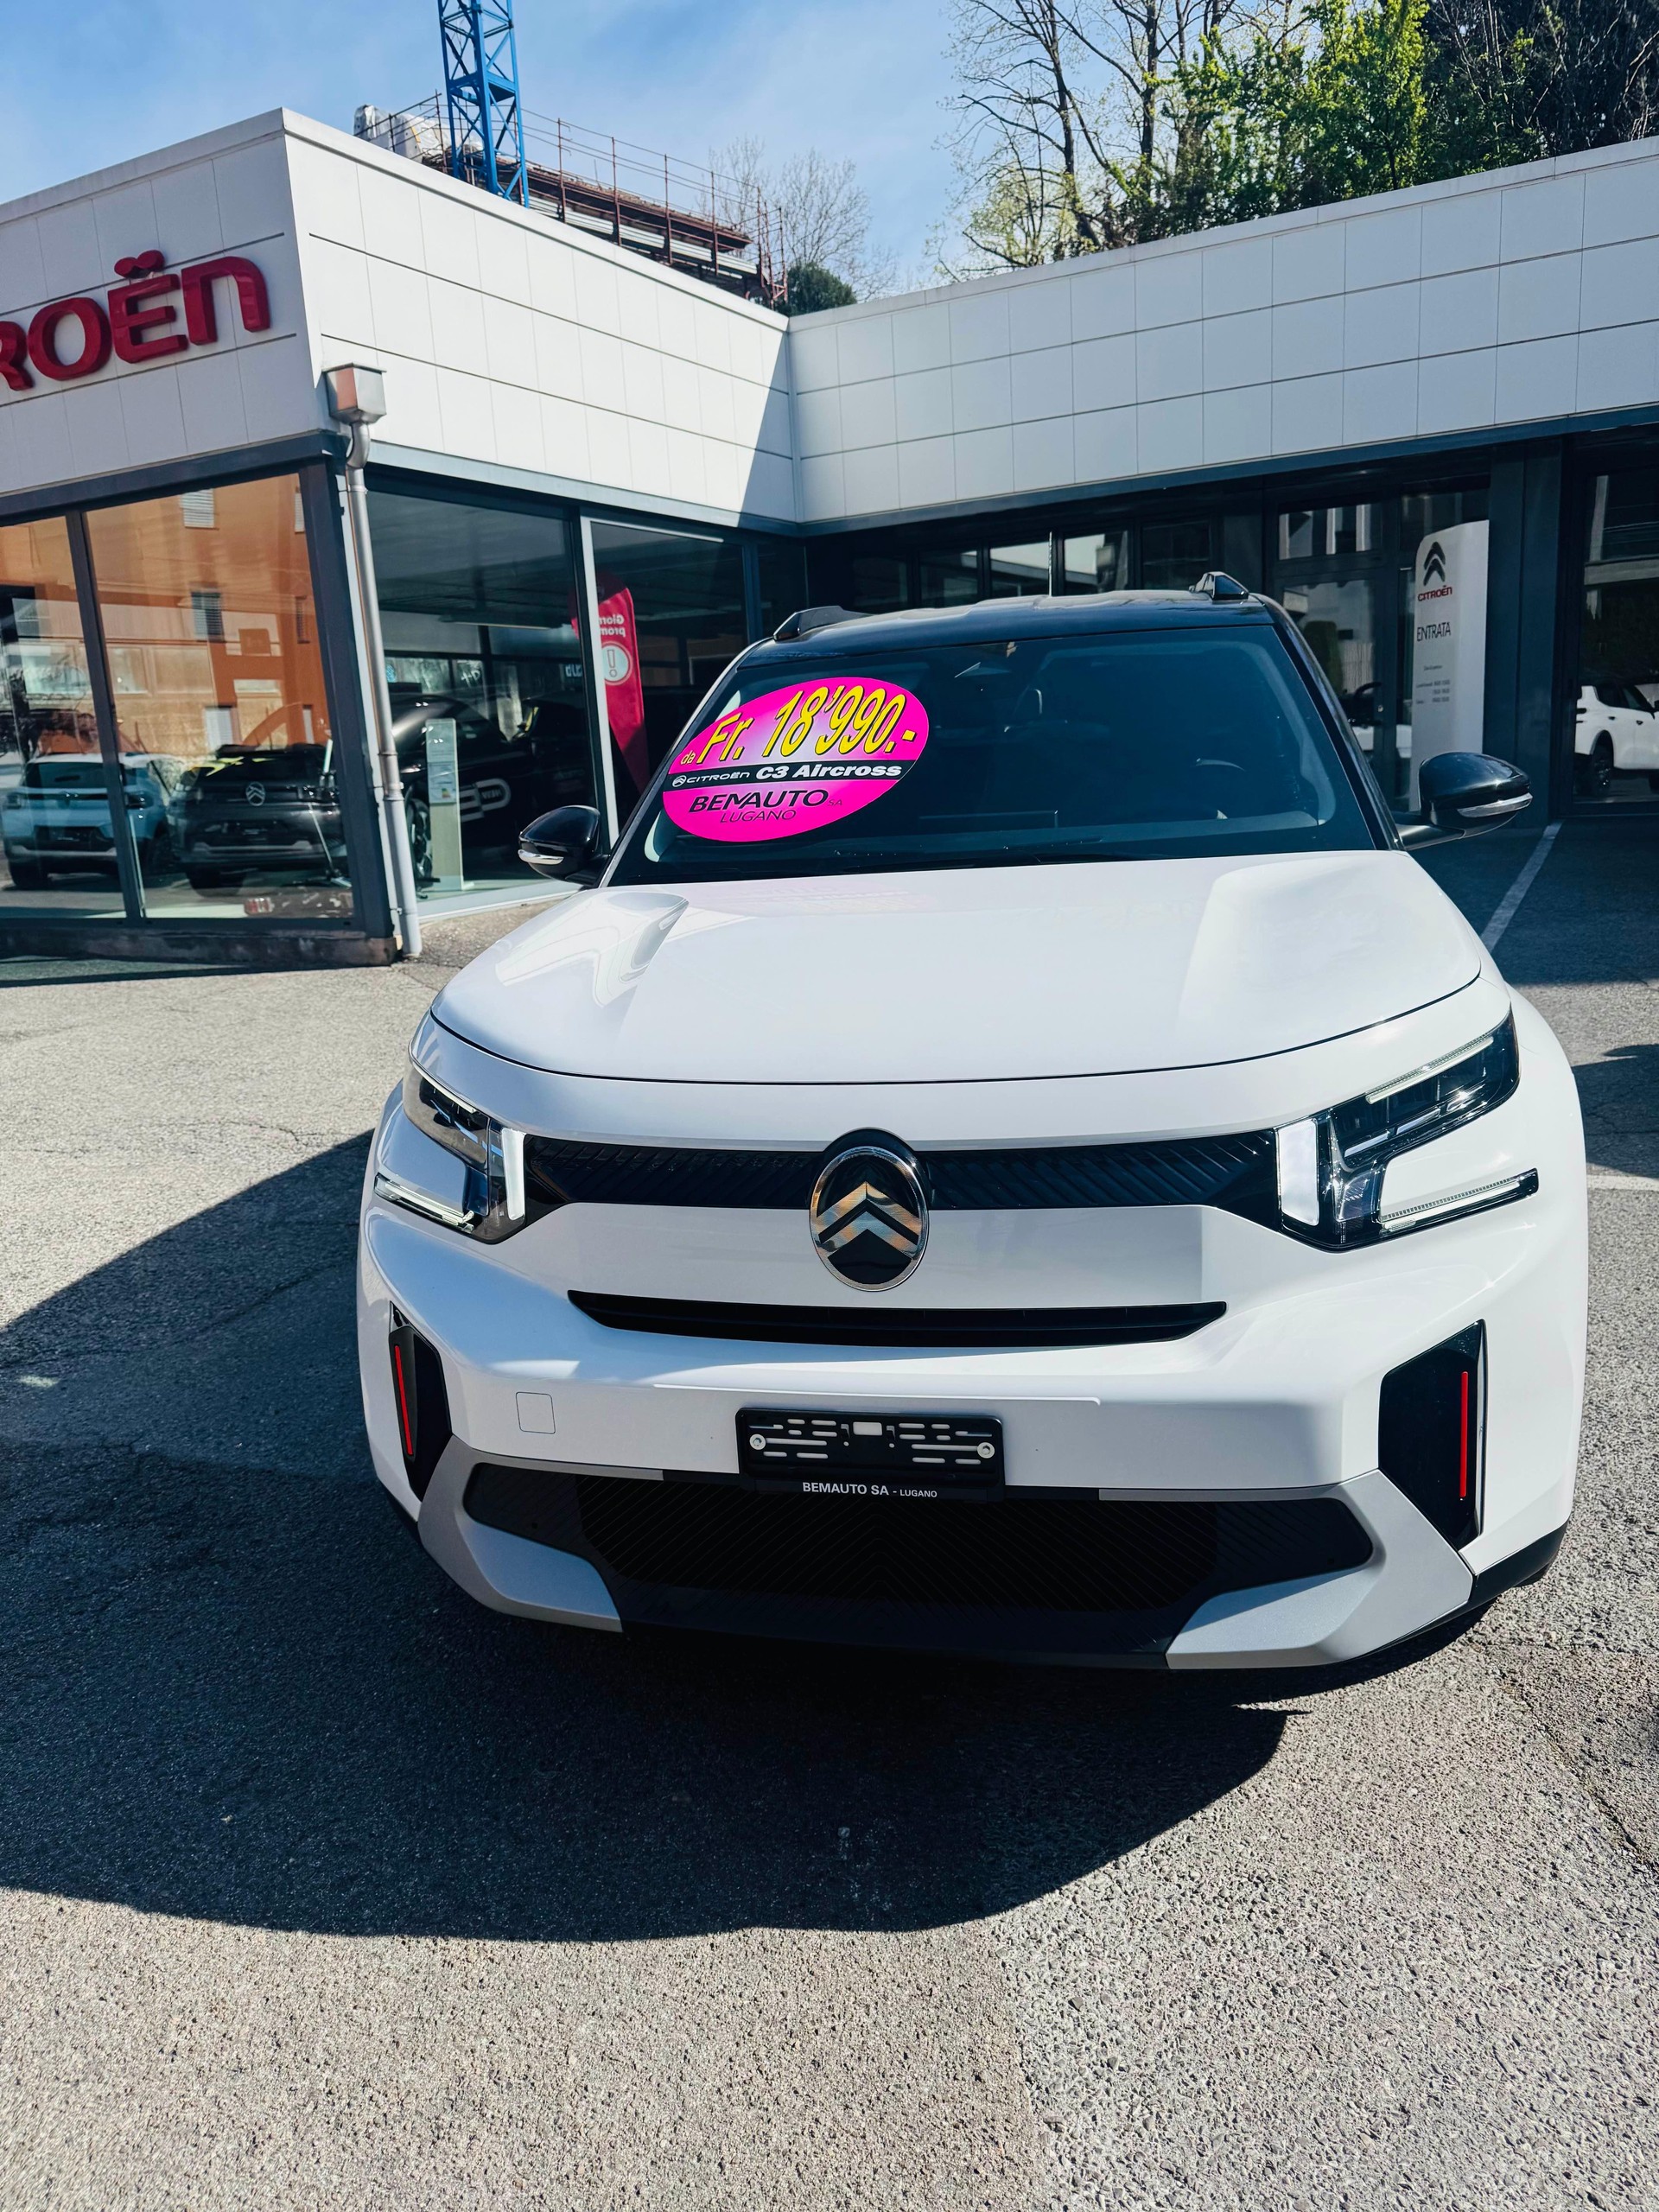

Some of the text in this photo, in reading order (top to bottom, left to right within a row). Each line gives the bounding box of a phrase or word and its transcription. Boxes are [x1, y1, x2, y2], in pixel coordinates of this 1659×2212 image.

[1417, 621, 1452, 641] ENTRATA
[680, 750, 696, 765] da
[696, 712, 755, 765] Fr.
[755, 765, 790, 780] C3
[792, 764, 902, 779] Aircross
[720, 810, 797, 823] LUGANO
[802, 1481, 868, 1495] BEMAUTO
[870, 1484, 889, 1496] SA
[899, 1489, 938, 1498] LUGANO
